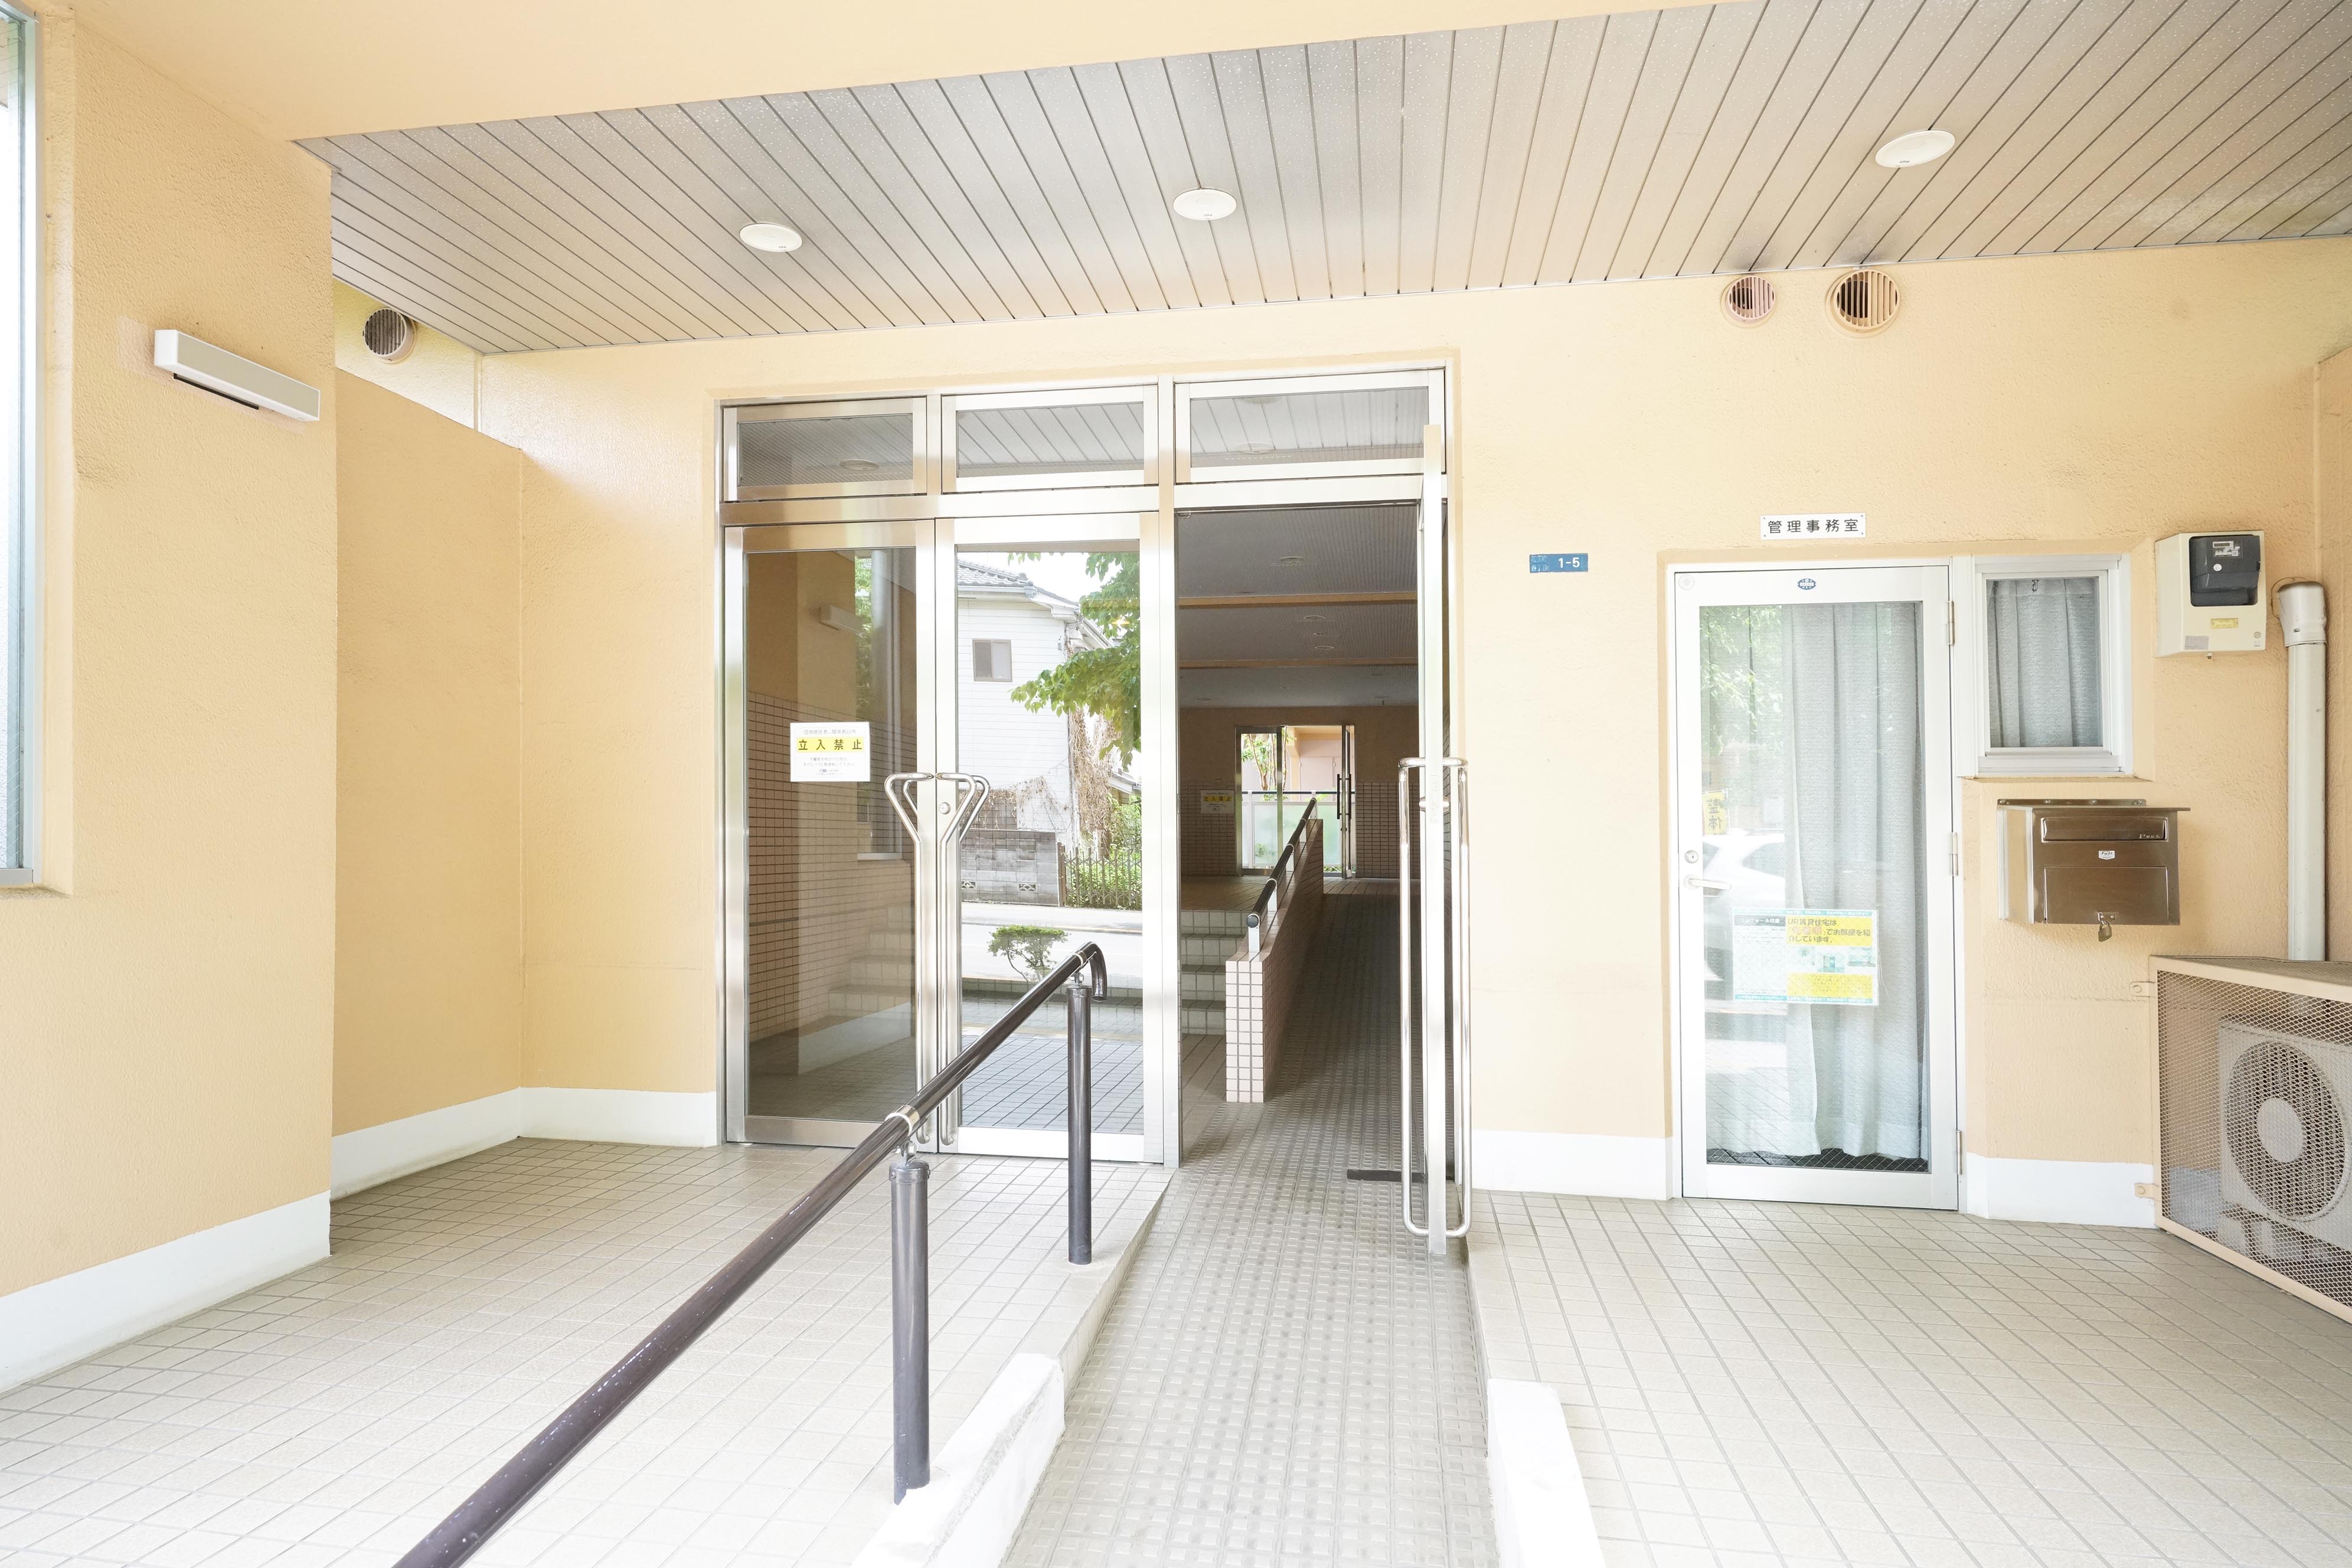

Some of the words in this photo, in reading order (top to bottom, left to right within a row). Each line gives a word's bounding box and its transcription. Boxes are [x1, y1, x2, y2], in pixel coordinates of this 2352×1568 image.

[1768, 518, 1858, 534] 管理事務室
[1558, 557, 1580, 569] 1-5
[798, 739, 863, 750] 立入禁止
